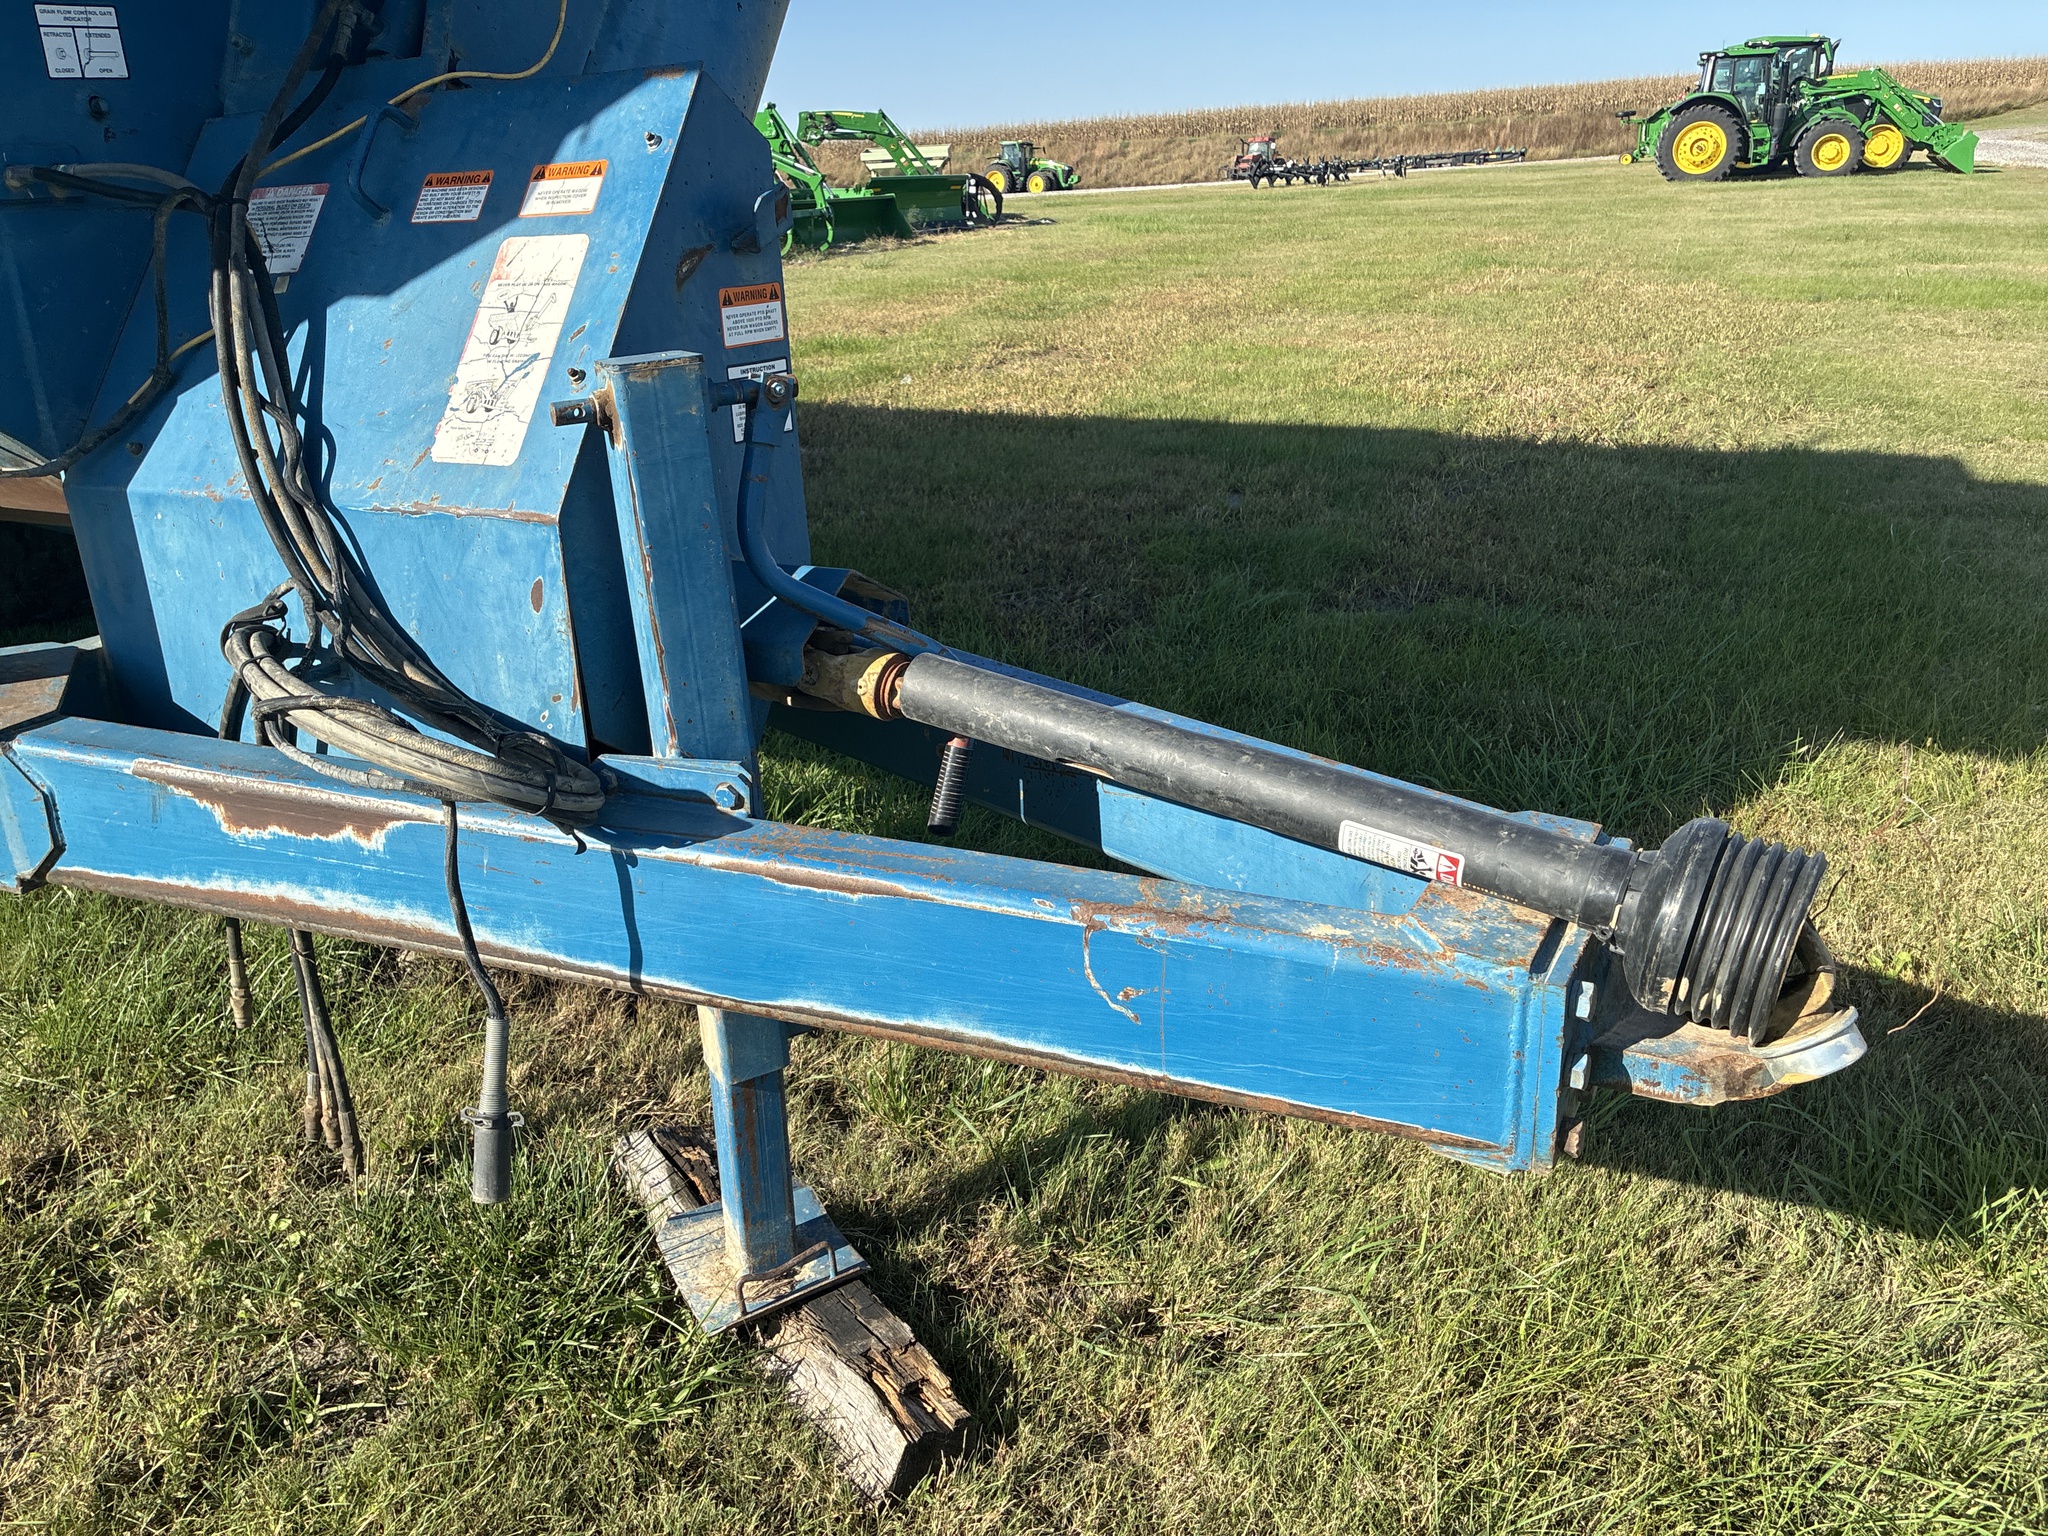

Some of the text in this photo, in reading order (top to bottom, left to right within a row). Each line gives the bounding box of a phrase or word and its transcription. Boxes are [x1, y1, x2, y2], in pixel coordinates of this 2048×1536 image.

[548, 165, 590, 177] WARNING
[436, 174, 481, 186] WARNING
[276, 186, 314, 196] DANGER
[733, 288, 767, 302] WARNING
[740, 364, 775, 375] INSTRUCTION
